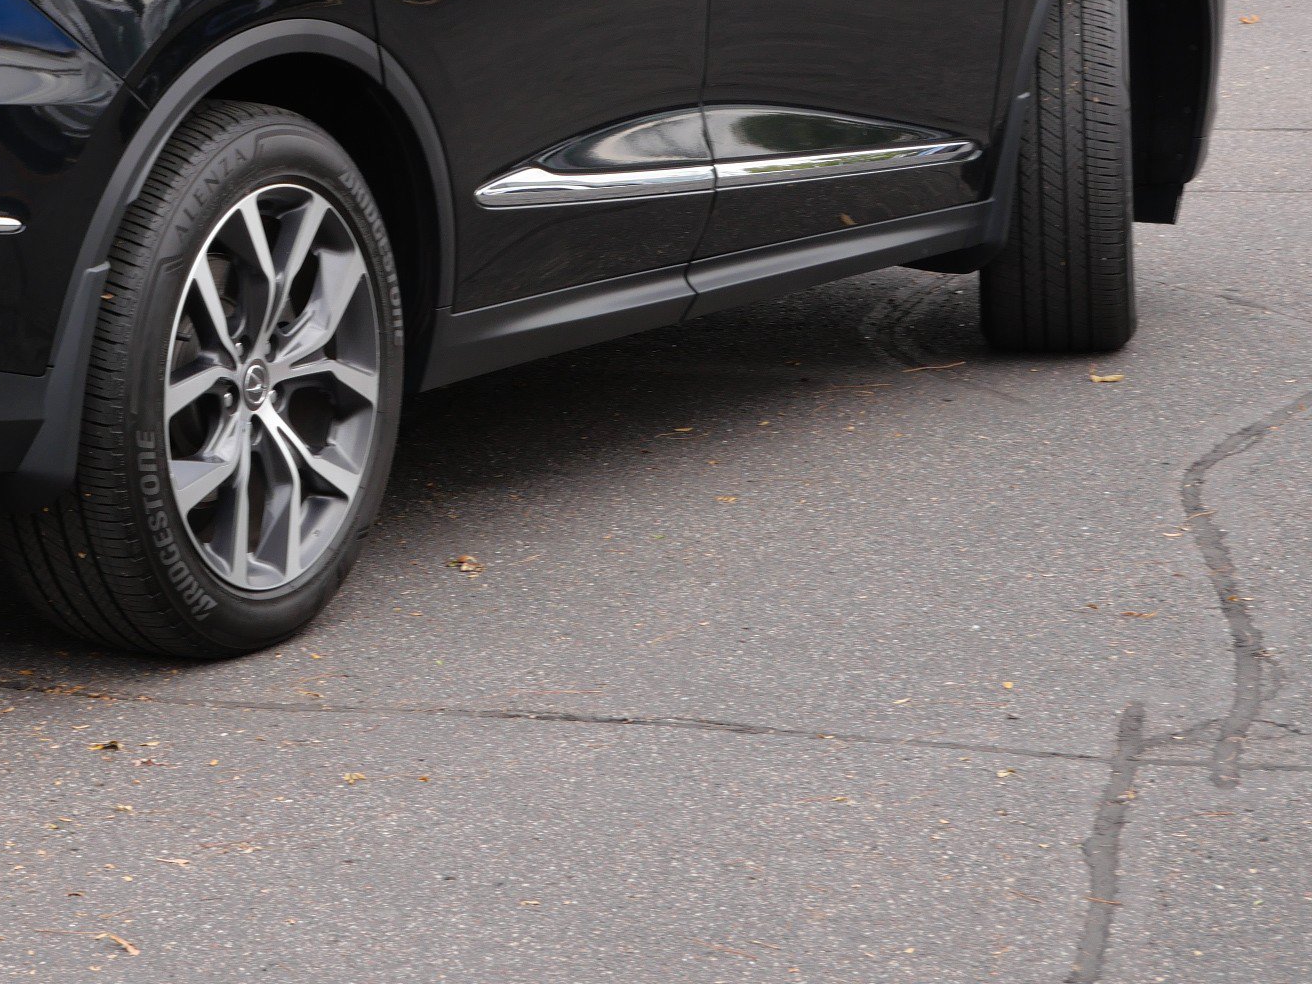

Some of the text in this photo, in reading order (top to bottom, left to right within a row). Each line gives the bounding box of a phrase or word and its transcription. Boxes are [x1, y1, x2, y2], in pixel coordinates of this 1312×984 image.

[175, 147, 247, 247] ALENZA
[338, 169, 404, 346] BRIDGESTONE
[135, 429, 218, 622] BRIDGESTONE
